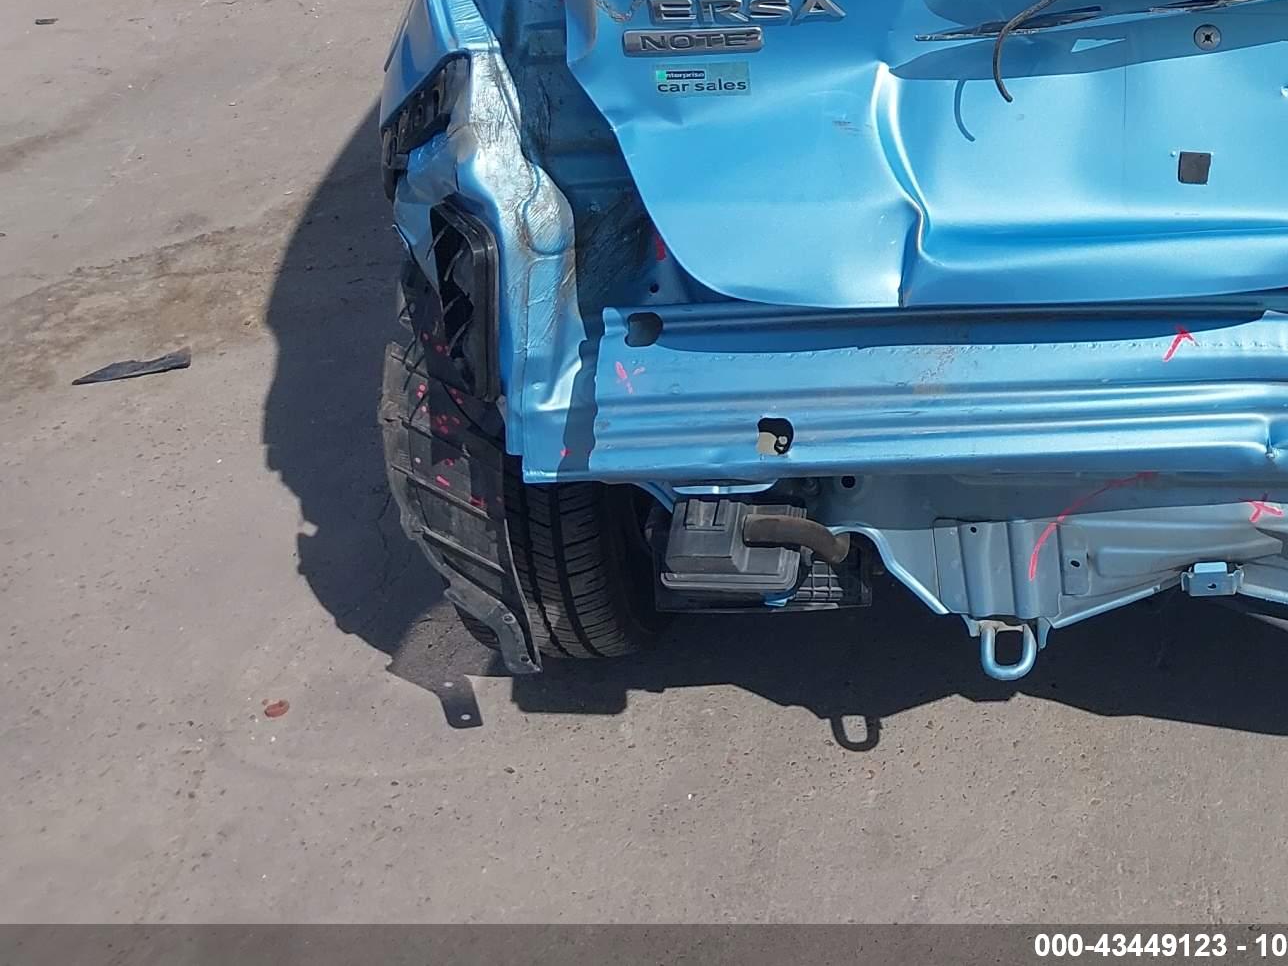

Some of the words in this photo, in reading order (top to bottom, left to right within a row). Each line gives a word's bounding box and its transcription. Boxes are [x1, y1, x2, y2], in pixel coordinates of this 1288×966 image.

[640, 32, 749, 52] NOTE
[658, 70, 706, 81] nterprise
[657, 82, 690, 93] car
[694, 77, 747, 92] sales
